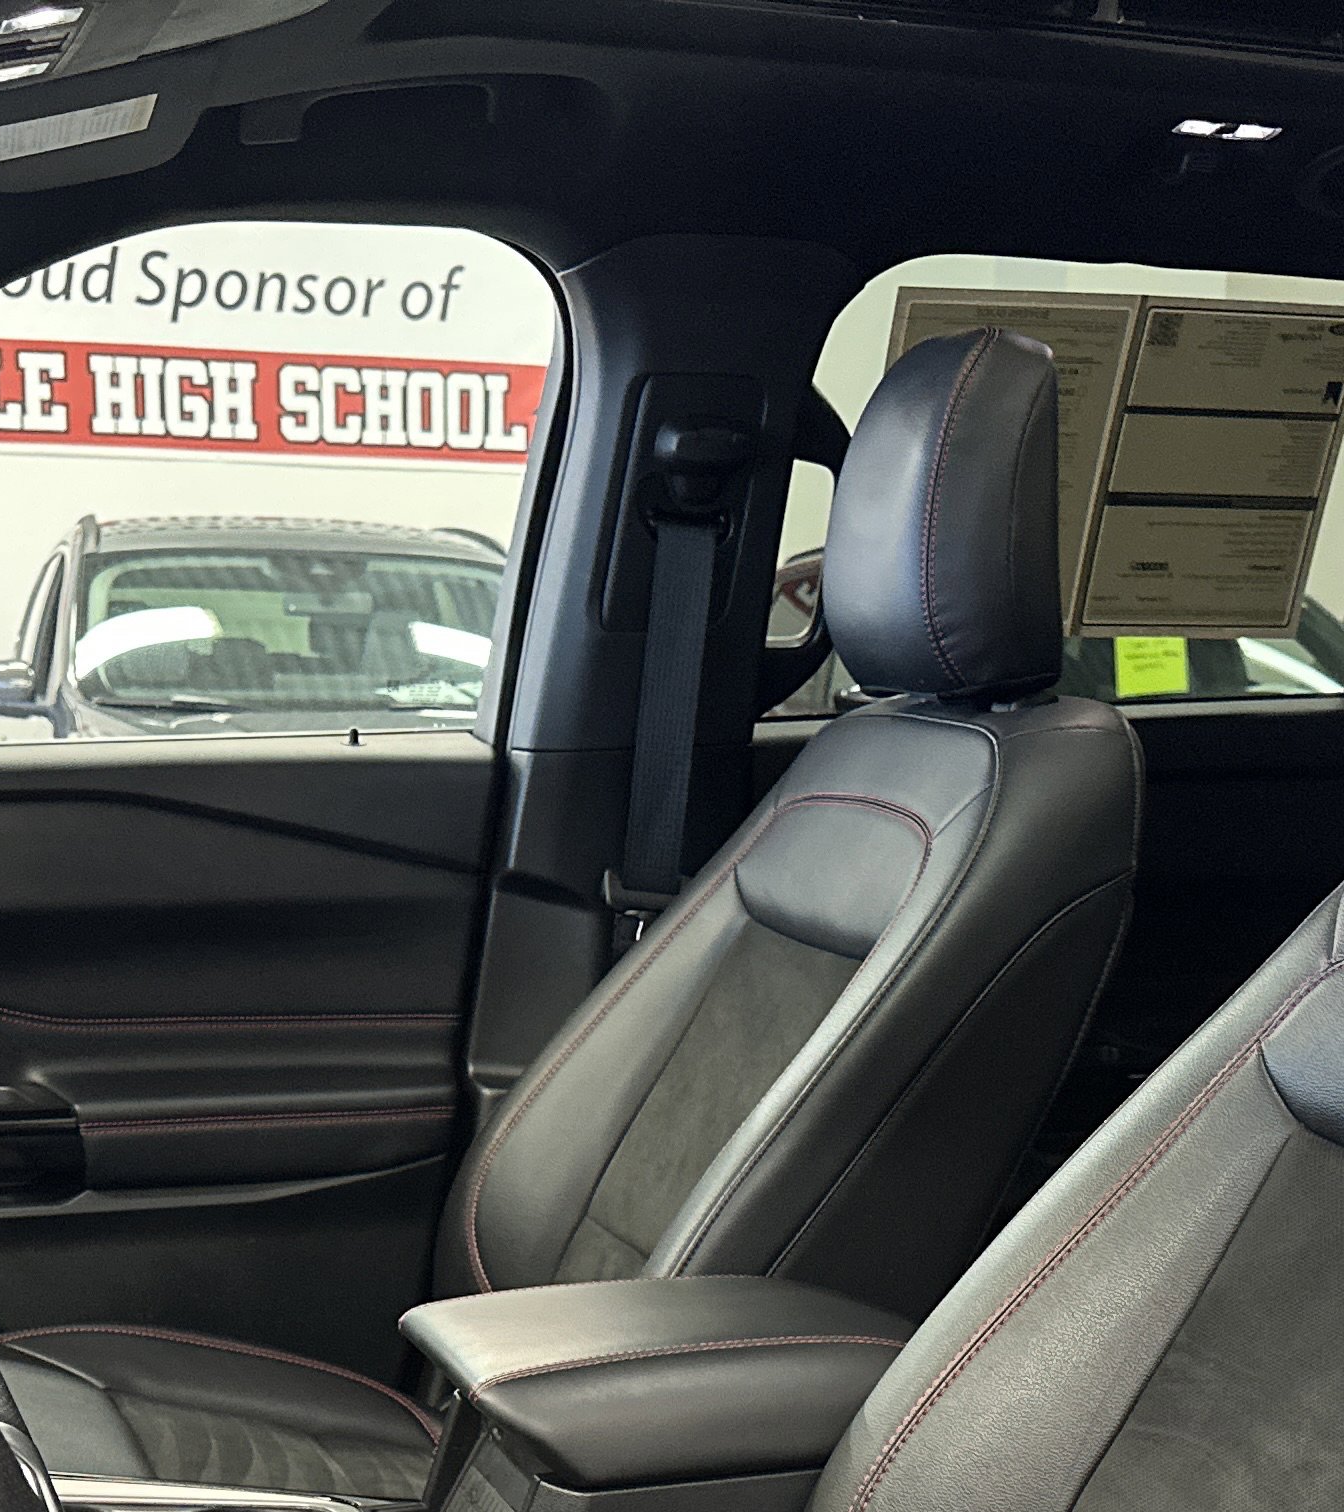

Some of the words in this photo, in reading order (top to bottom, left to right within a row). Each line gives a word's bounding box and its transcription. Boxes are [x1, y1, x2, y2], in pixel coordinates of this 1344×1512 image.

[136, 250, 385, 323] Sponsor
[401, 265, 464, 321] of
[88, 353, 258, 440] HIGH
[277, 364, 529, 452] SCHOOL
